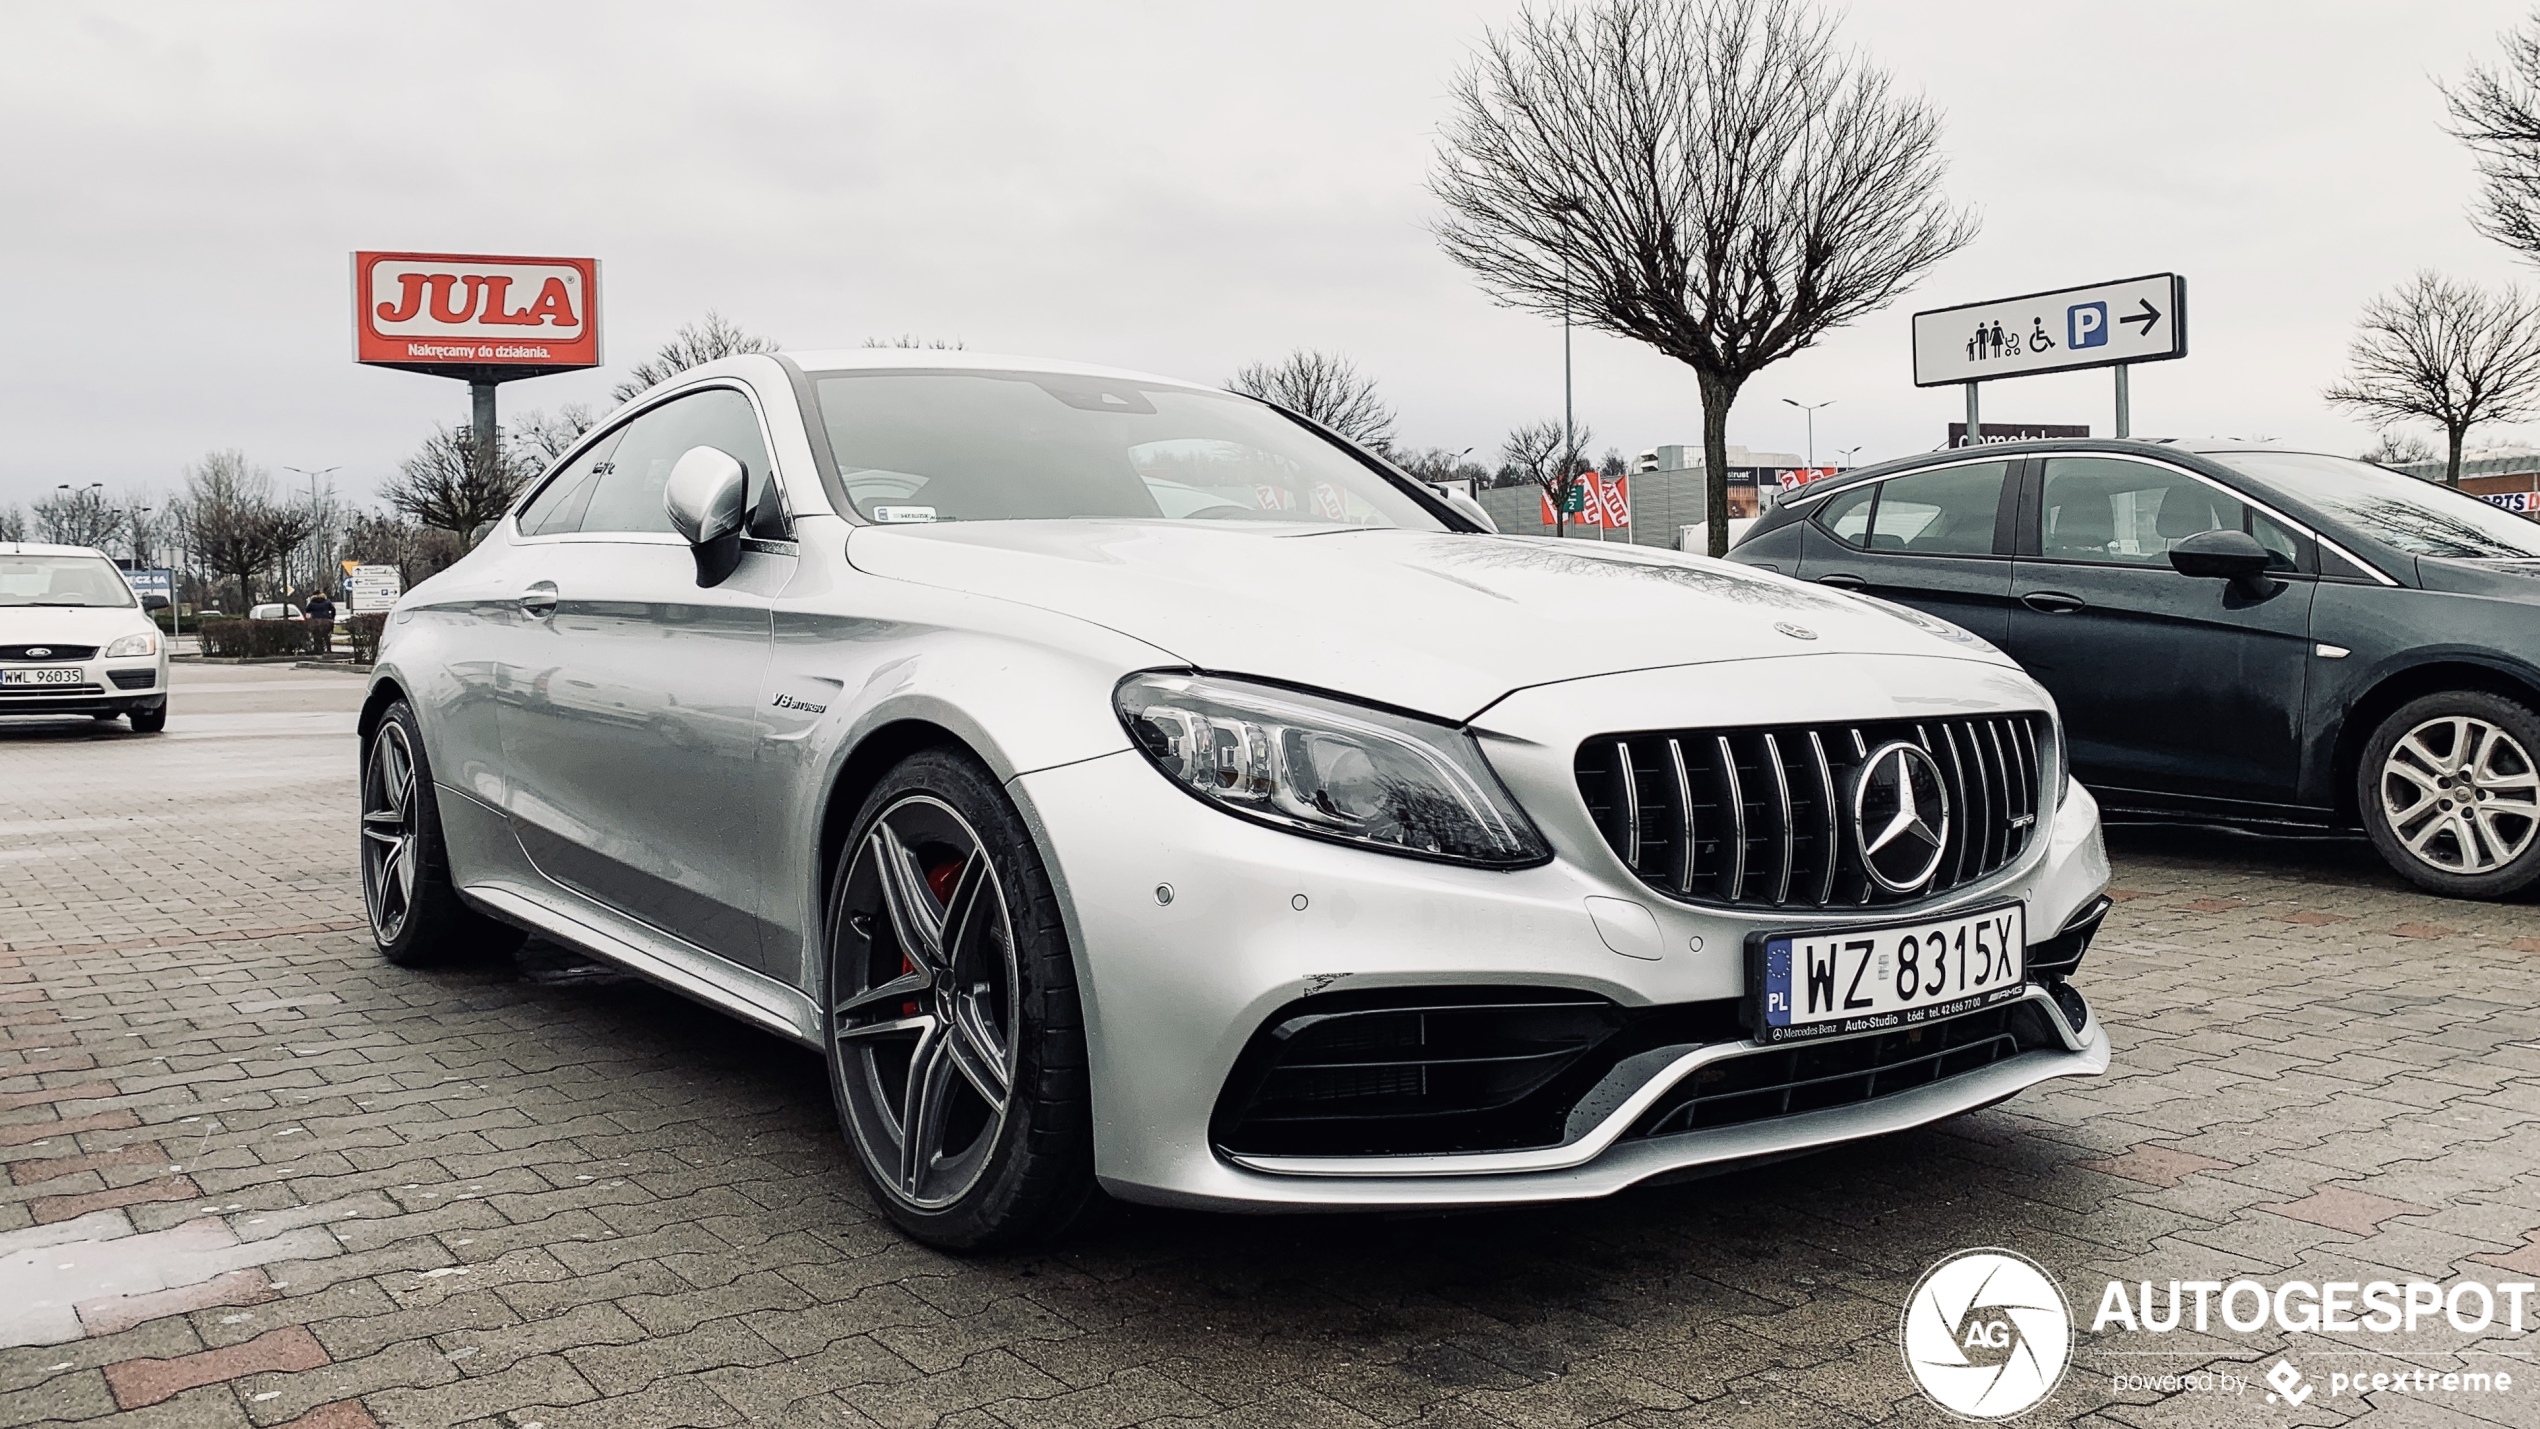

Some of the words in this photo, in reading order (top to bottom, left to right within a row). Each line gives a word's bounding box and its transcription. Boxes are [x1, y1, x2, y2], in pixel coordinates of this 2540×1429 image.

[376, 273, 579, 326] JULA
[2074, 307, 2102, 346] P
[408, 344, 475, 359] Nakręcamy
[478, 345, 494, 357] do
[496, 345, 550, 358] działania.
[1568, 501, 1575, 510] 2
[4, 671, 31, 683] WWL
[36, 670, 80, 683] 96035
[772, 692, 793, 708] V8
[1806, 939, 1875, 1014] WZ
[1896, 914, 2013, 1001] 8315X
[1768, 992, 1788, 1013] PL
[1845, 1014, 1898, 1032] Auto-Studio
[1907, 1009, 1925, 1022] Łódź
[1929, 1006, 1940, 1018] tel.
[1941, 1004, 1950, 1015] 42
[1964, 999, 1972, 1010] 77
